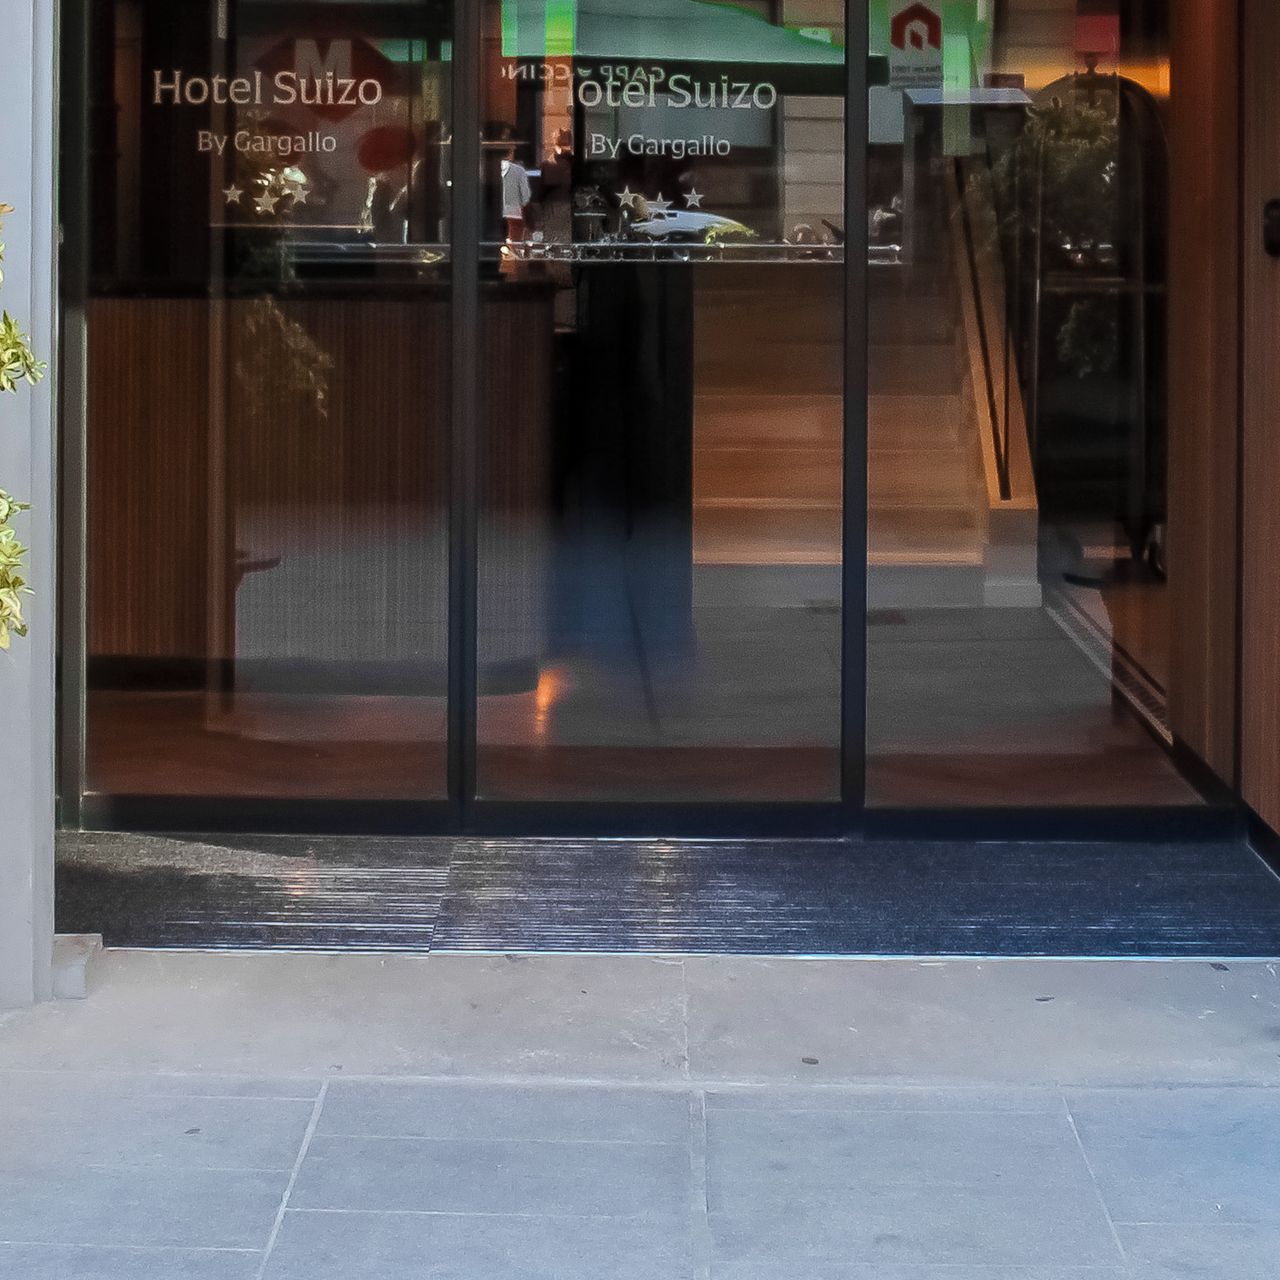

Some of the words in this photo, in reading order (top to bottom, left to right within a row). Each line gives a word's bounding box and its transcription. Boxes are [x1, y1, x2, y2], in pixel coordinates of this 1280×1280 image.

[153, 70, 263, 105] Hotel
[273, 71, 383, 106] Suizo
[667, 74, 777, 110] Suizo
[198, 131, 228, 154] By
[234, 131, 337, 155] Gargallo
[590, 133, 621, 158] By
[627, 133, 731, 160] Gargallo
